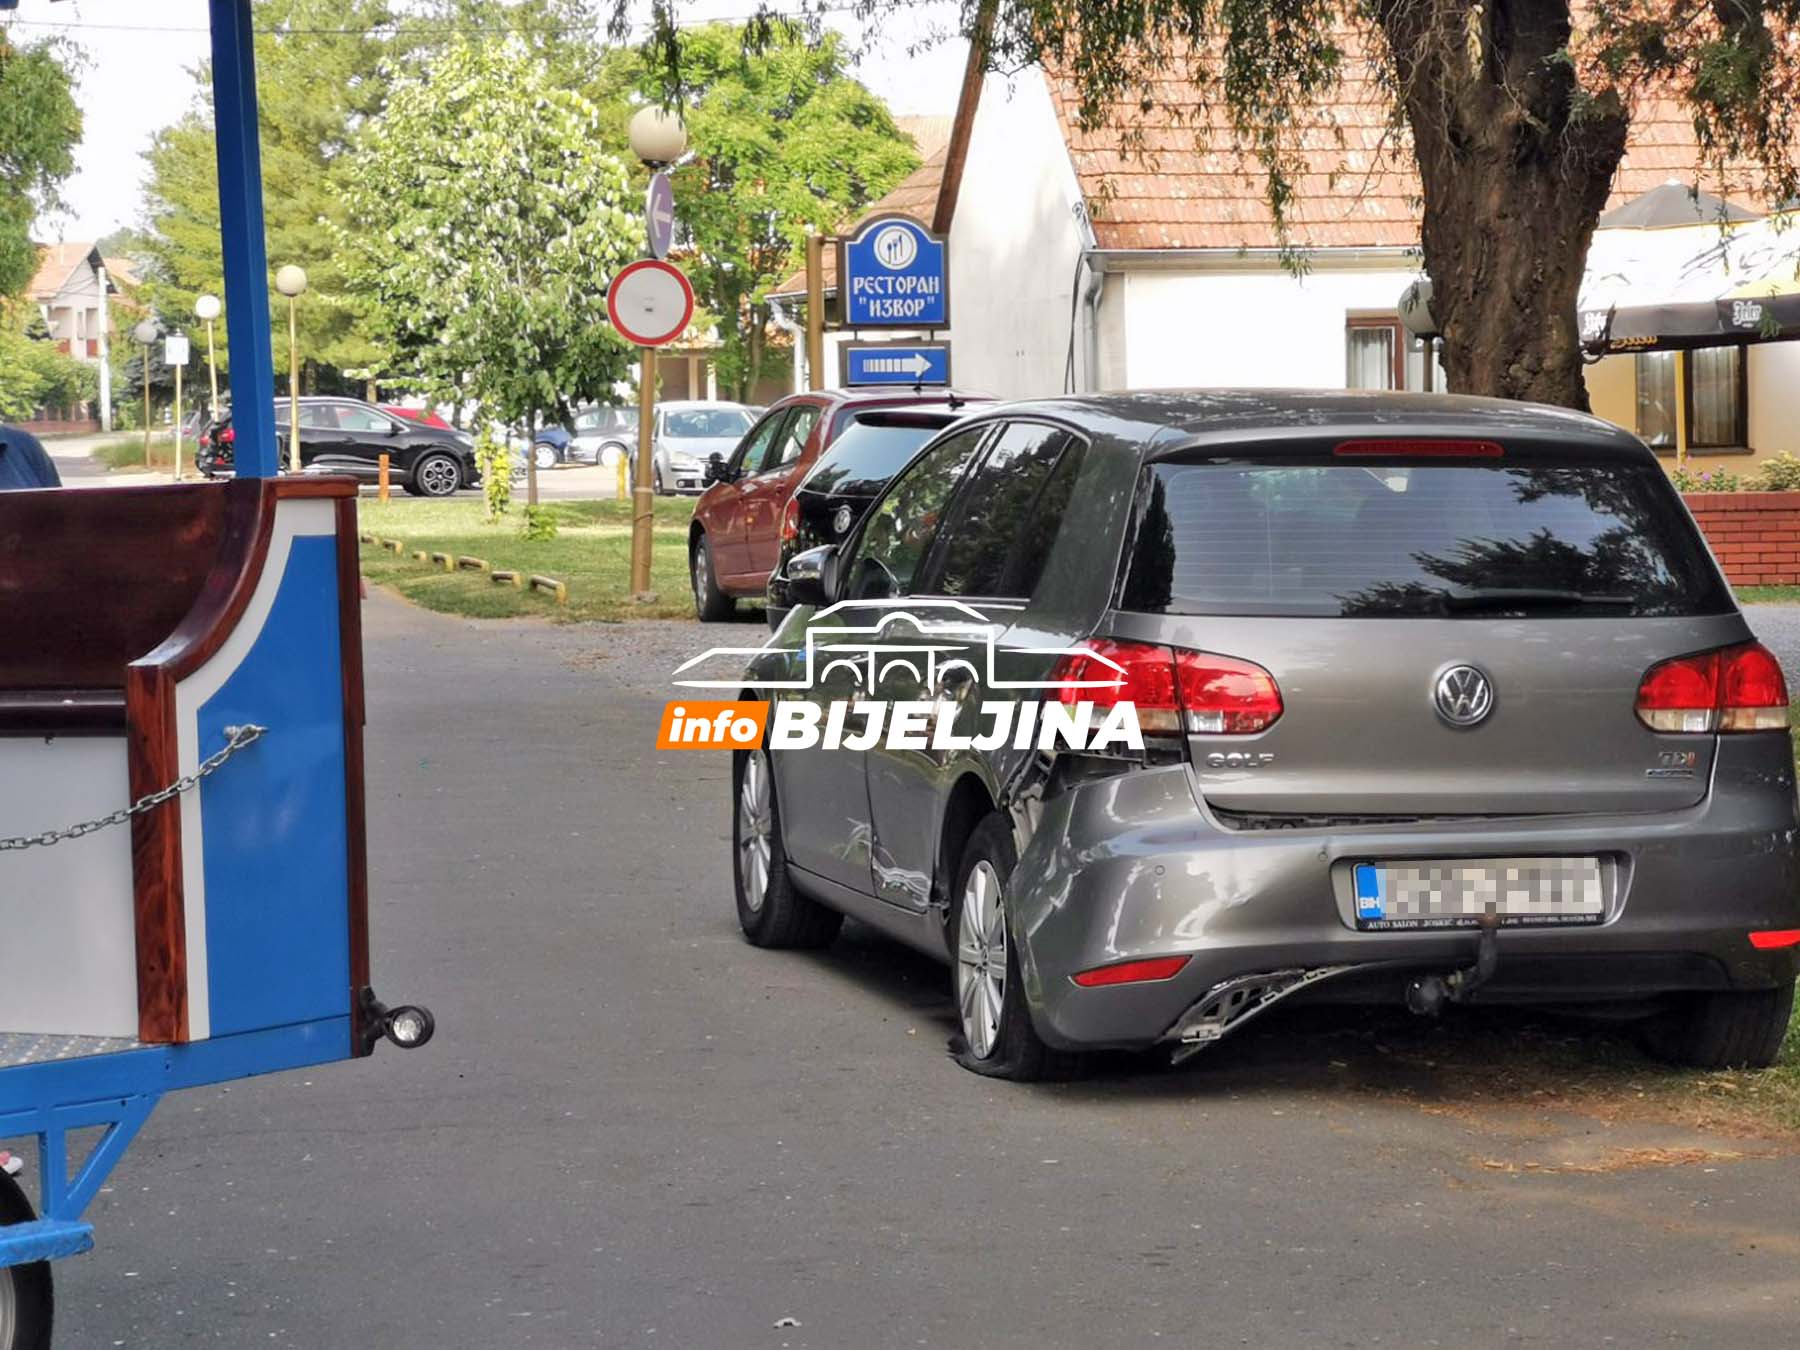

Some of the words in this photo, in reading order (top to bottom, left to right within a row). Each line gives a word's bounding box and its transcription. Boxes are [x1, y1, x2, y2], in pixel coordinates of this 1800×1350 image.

[853, 276, 940, 295] РЕСТОРАН
[1207, 752, 1275, 768] GOLF
[1367, 921, 1390, 929] AUTO
[1392, 920, 1418, 928] SALON
